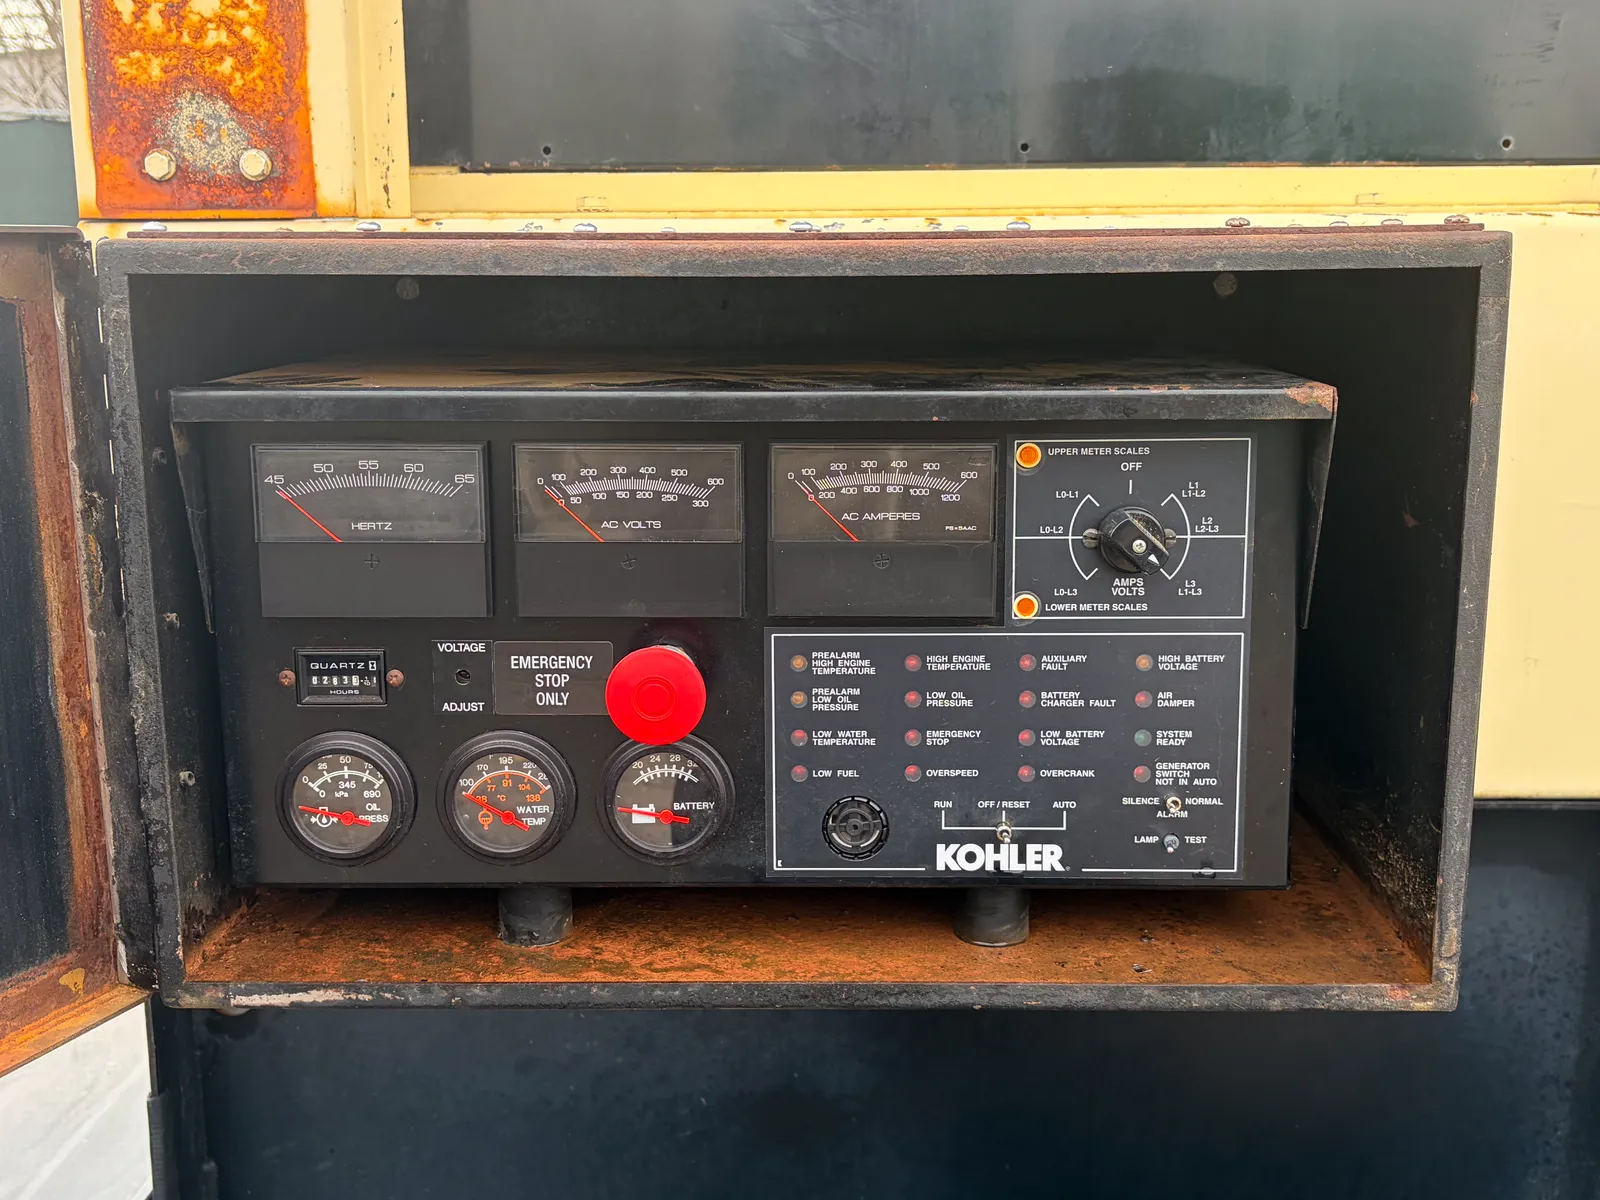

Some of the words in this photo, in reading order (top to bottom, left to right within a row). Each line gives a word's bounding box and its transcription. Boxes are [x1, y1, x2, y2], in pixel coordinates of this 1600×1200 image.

[1114, 447, 1150, 455] SCALES
[1121, 463, 1142, 471] OFF
[264, 475, 284, 484] 45
[313, 464, 333, 473] 50
[359, 461, 379, 469] 55
[404, 464, 424, 472] 60
[455, 475, 475, 483] 65
[961, 471, 977, 479] 600
[1113, 578, 1144, 586] AMPS
[1112, 587, 1145, 596] VOLTS
[438, 643, 486, 652] VOLTAGE
[510, 656, 593, 669] EMERGENCY
[535, 674, 569, 687] STOP
[536, 692, 569, 705] ONLY
[443, 703, 484, 711] ADJUST
[339, 781, 356, 789] 345
[363, 790, 380, 798] 690
[526, 794, 541, 802] 138
[366, 803, 380, 811] OIL
[673, 802, 715, 810] BATTERY
[936, 844, 1065, 871] KOHLER
